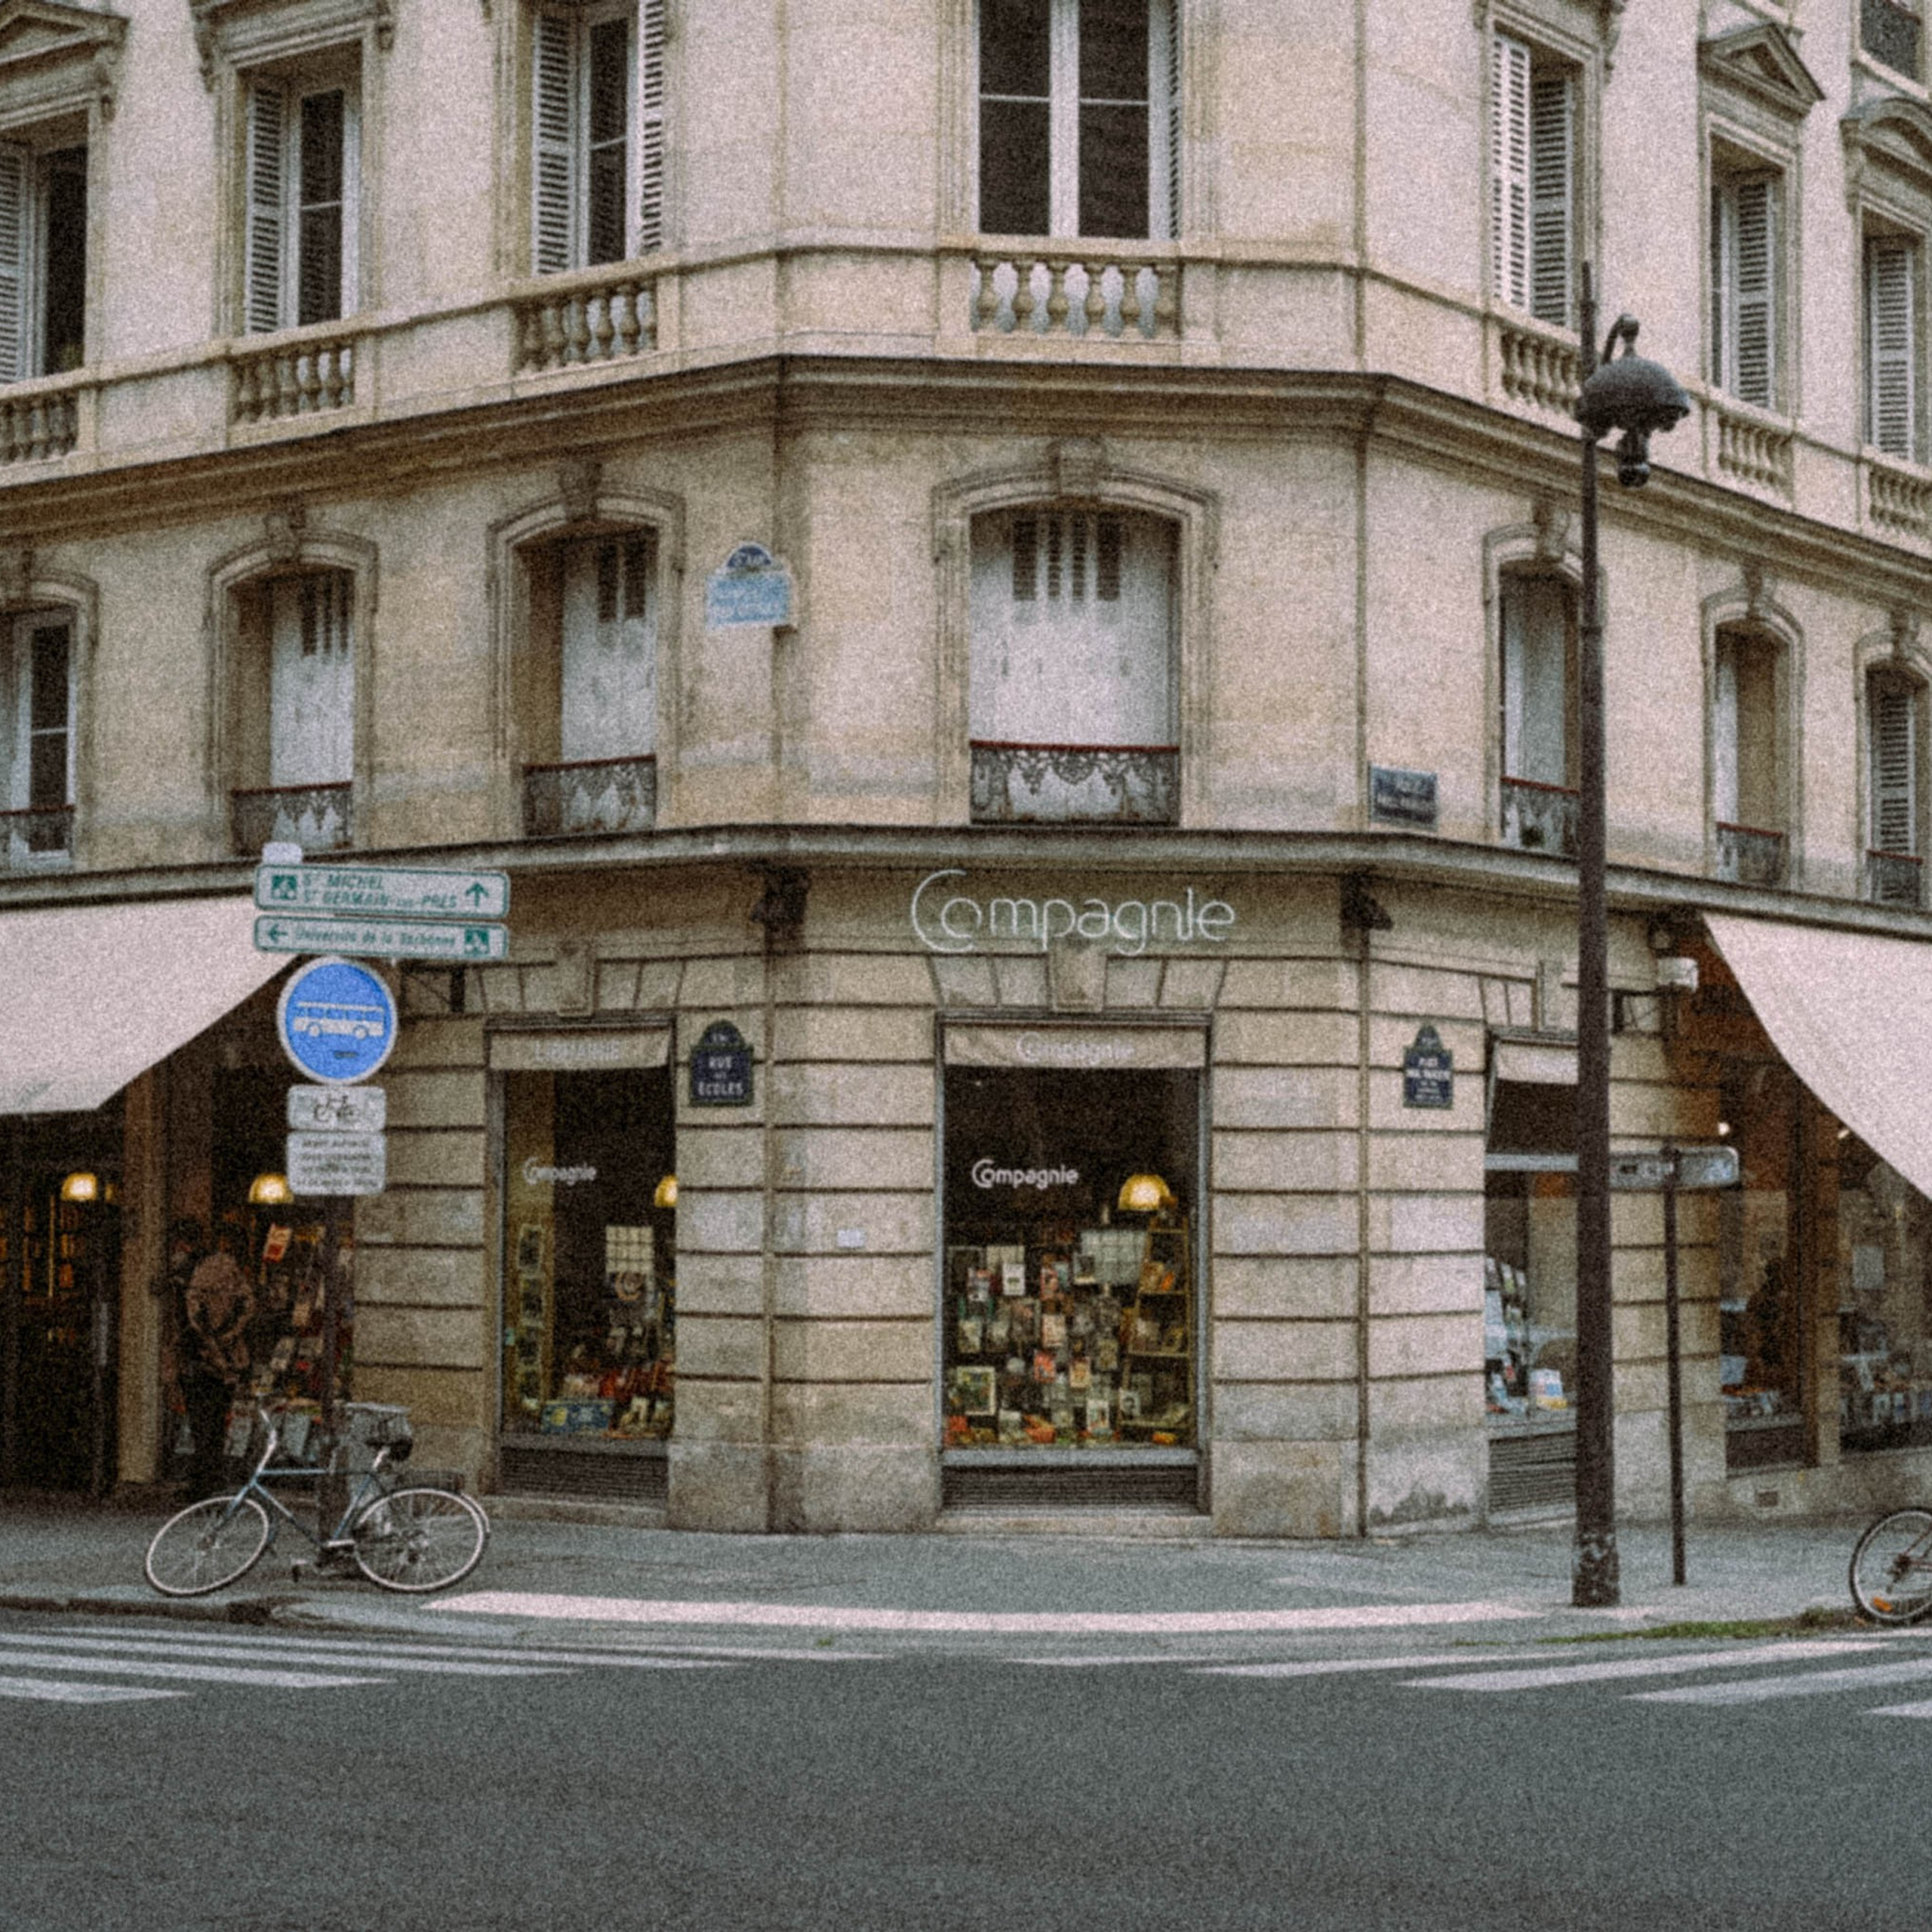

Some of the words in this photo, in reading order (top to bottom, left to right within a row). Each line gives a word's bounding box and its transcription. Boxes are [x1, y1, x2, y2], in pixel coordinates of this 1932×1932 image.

[326, 875, 383, 890] MICHEL
[911, 869, 1235, 956] Compagnie
[709, 1055, 732, 1069] RUE
[972, 1158, 1079, 1190] Compagnie
